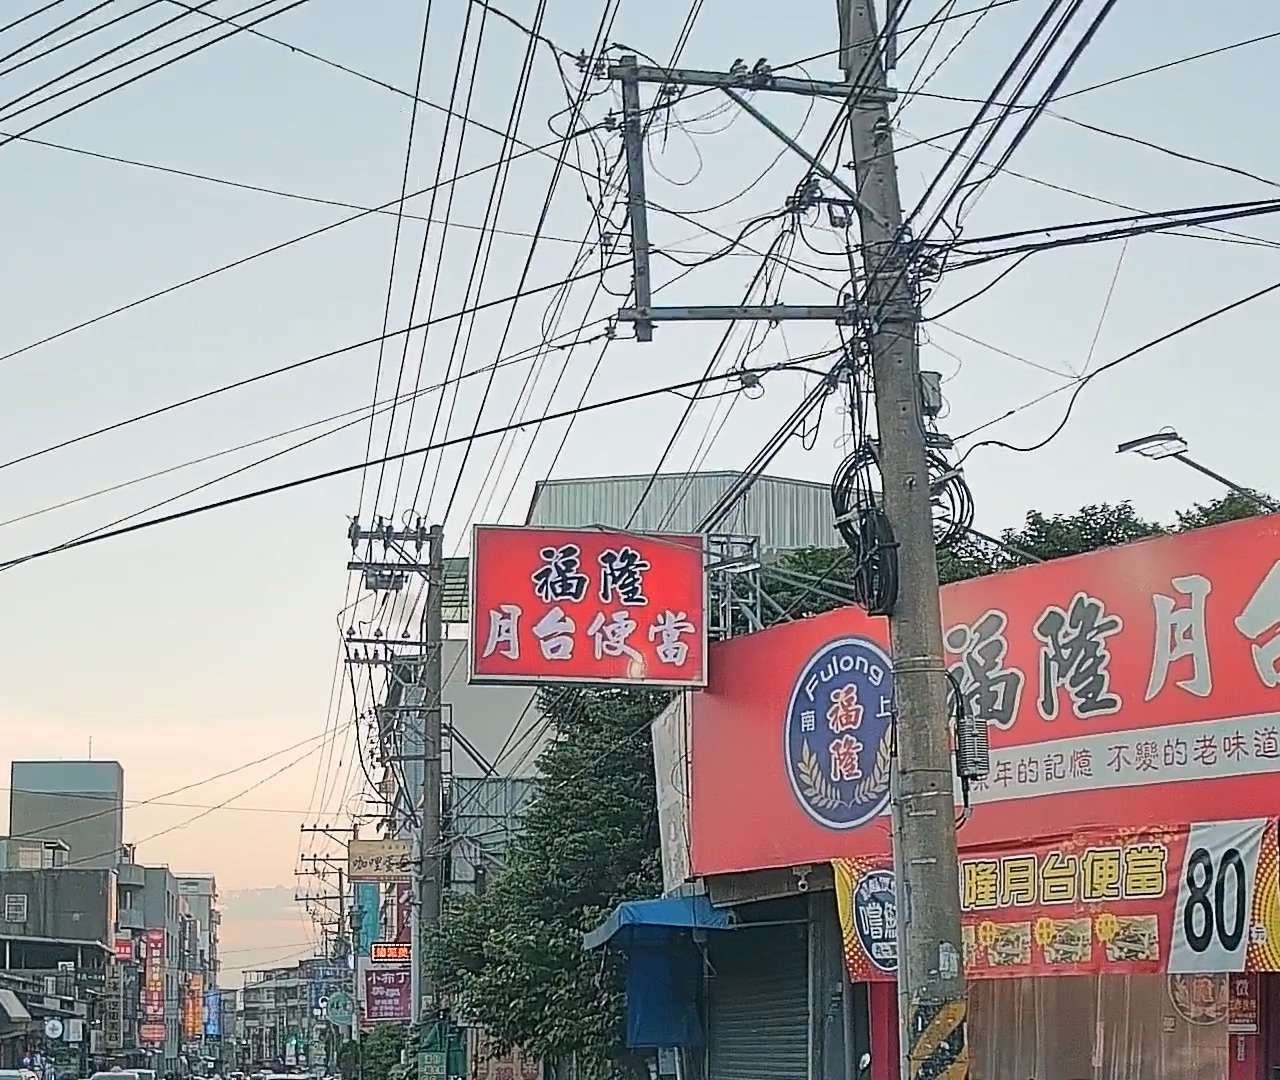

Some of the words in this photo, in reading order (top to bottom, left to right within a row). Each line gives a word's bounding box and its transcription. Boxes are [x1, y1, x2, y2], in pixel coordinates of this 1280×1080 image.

[532, 543, 651, 605] 福隆
[482, 604, 696, 668] 月台便當
[805, 654, 885, 702] Fulong
[801, 710, 816, 732] 南
[826, 683, 864, 782] 福隆
[1106, 725, 1280, 773] 不變的老味道
[1183, 846, 1247, 954] 80
